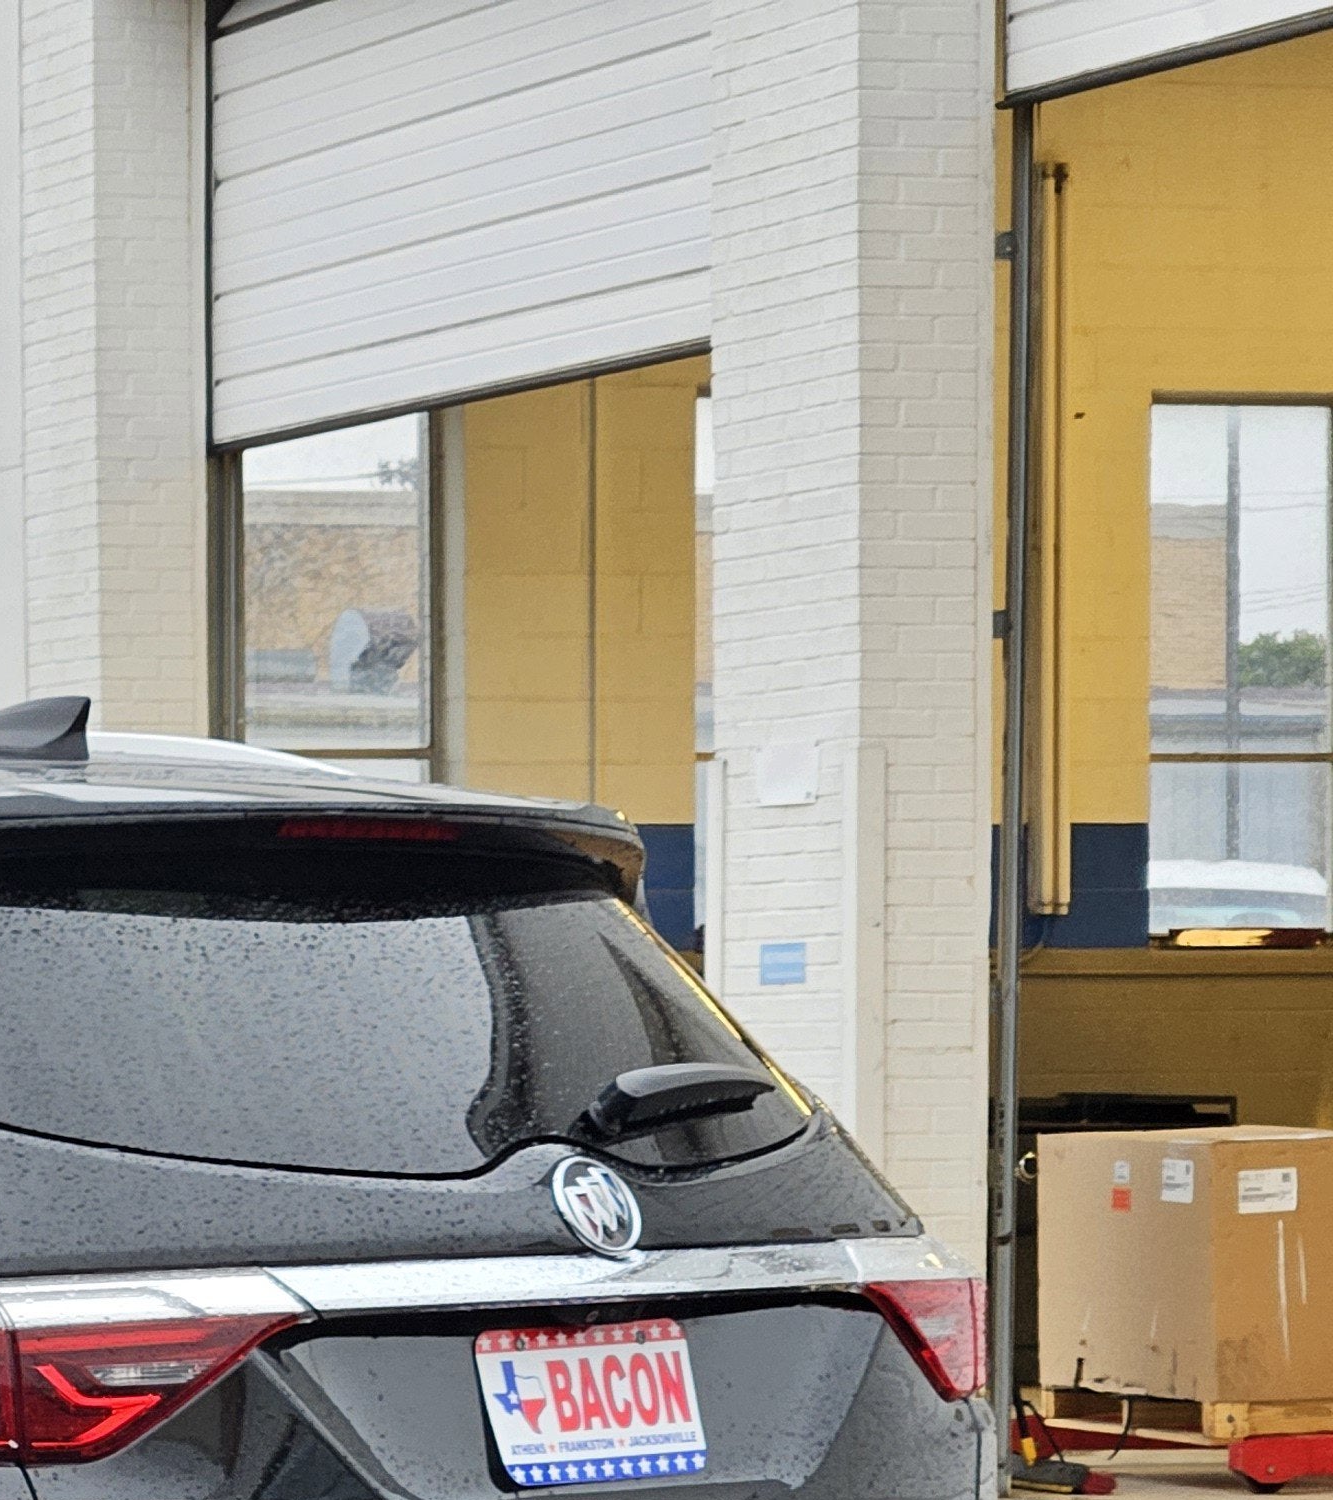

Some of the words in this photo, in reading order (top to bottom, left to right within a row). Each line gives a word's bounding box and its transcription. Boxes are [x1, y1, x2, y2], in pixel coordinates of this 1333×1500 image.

[545, 1351, 692, 1432] BACON
[511, 1442, 546, 1456] ATHENS
[558, 1438, 615, 1453] FRANKSTON
[628, 1431, 697, 1448] JACKSONVILLE
